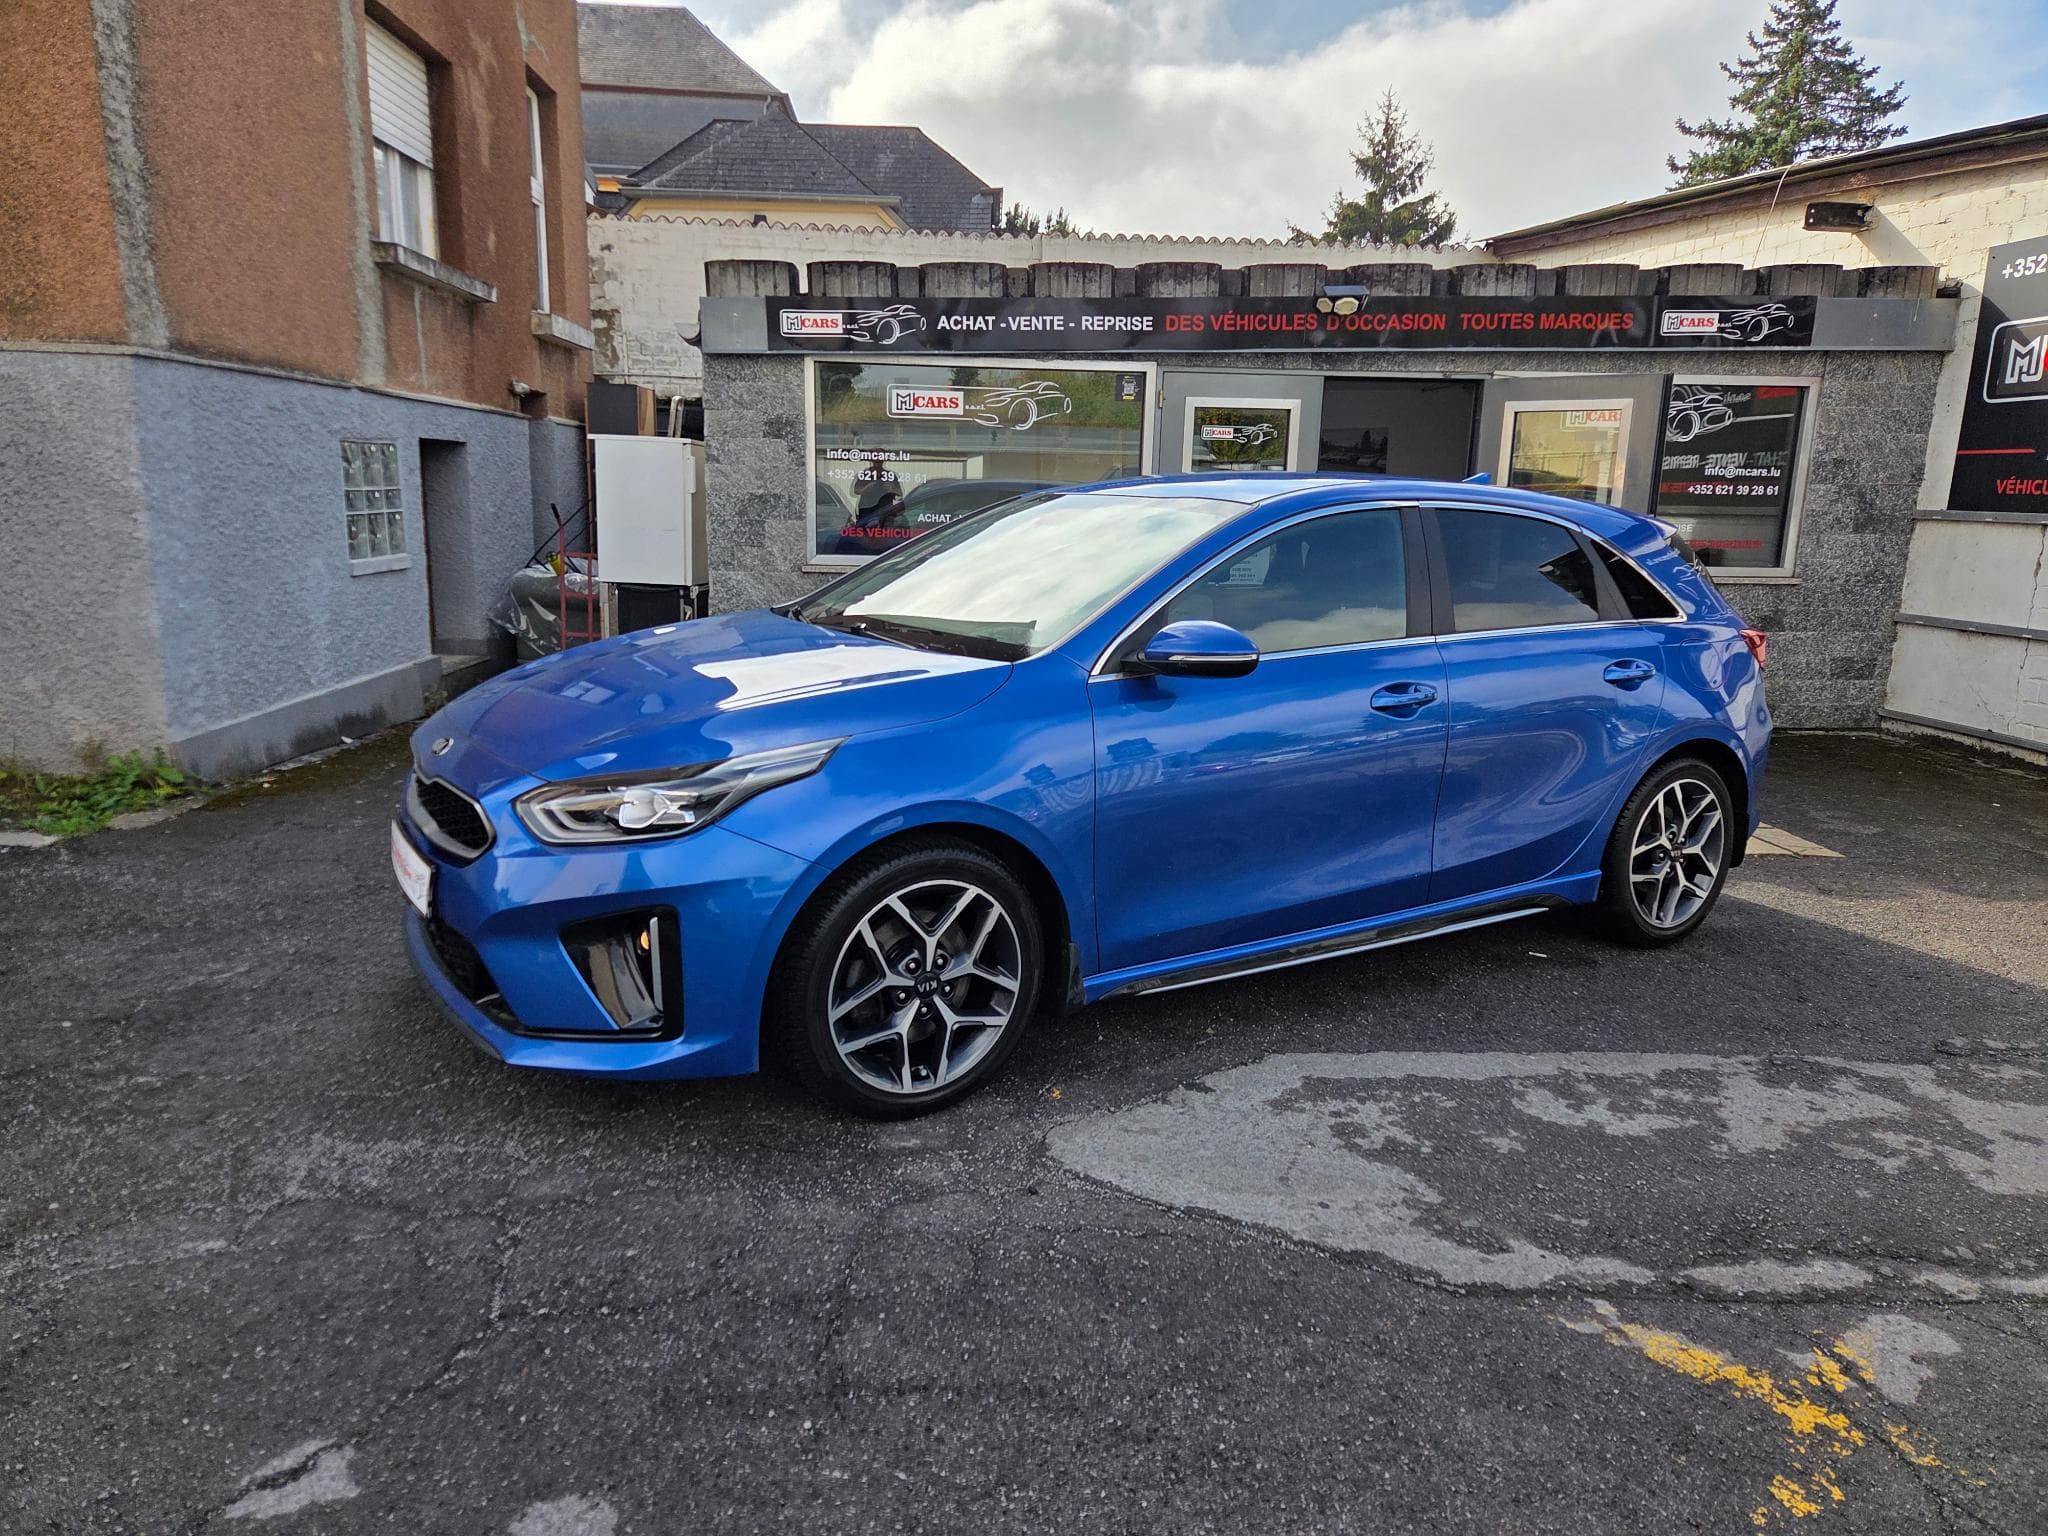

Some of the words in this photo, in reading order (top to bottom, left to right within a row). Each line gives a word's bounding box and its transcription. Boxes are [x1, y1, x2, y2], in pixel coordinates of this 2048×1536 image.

[937, 315, 996, 331] ACHAT
[1008, 316, 1064, 331] VENTE
[1082, 317, 1153, 332] REPRISE
[1166, 316, 1204, 331] DES
[1210, 311, 1318, 331] VÉHICULES
[1461, 313, 1534, 329] TOUTES
[1539, 313, 1633, 330] MARQUES
[826, 448, 911, 462] info@mcars.lu
[827, 468, 855, 480] +352
[858, 470, 878, 481] 621
[881, 470, 895, 482] 39
[898, 472, 912, 482] 28
[1704, 466, 1781, 478] info@mcars.lu
[1688, 484, 1713, 495] +352
[1715, 485, 1734, 495] 621
[1736, 485, 1750, 496] 39
[1751, 485, 1765, 496] 28
[1766, 485, 1780, 496] 61
[917, 513, 952, 524] ACHAT
[840, 527, 866, 538] DES
[917, 980, 937, 992] KIA
